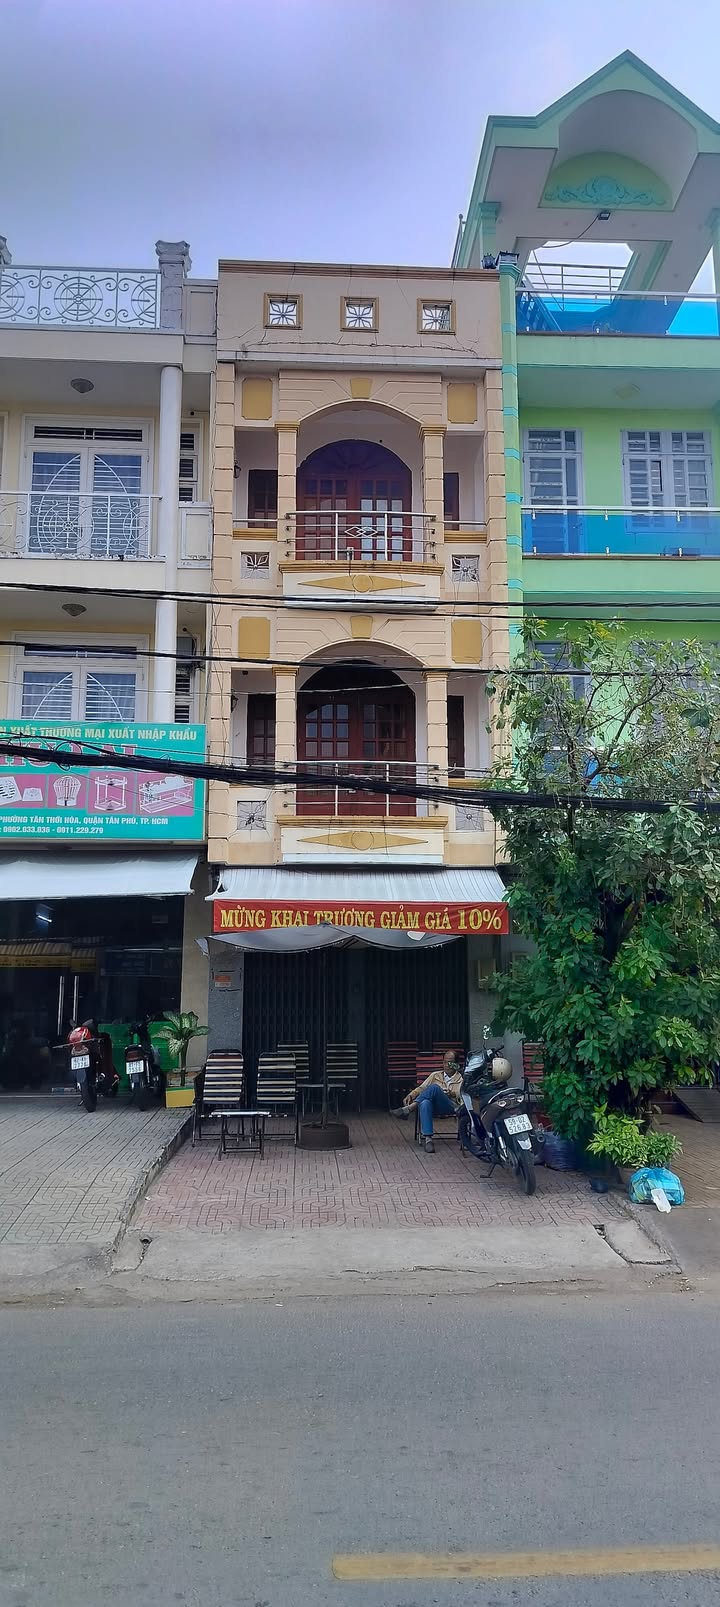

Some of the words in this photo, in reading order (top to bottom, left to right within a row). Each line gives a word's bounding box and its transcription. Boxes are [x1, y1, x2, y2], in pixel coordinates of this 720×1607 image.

[85, 728, 105, 740] MẠI
[108, 726, 135, 739] XUẤT
[137, 728, 166, 741] NHẬP
[169, 727, 197, 740] KHẨU
[83, 816, 104, 826] QUẬN
[105, 816, 119, 824] TÂN
[220, 905, 266, 928] MỪNG
[270, 909, 309, 928] KHAI
[313, 907, 376, 929] TRƯƠNG
[380, 904, 420, 929] GIẢM
[424, 907, 452, 930] GIÁ
[458, 908, 502, 930] 10%
